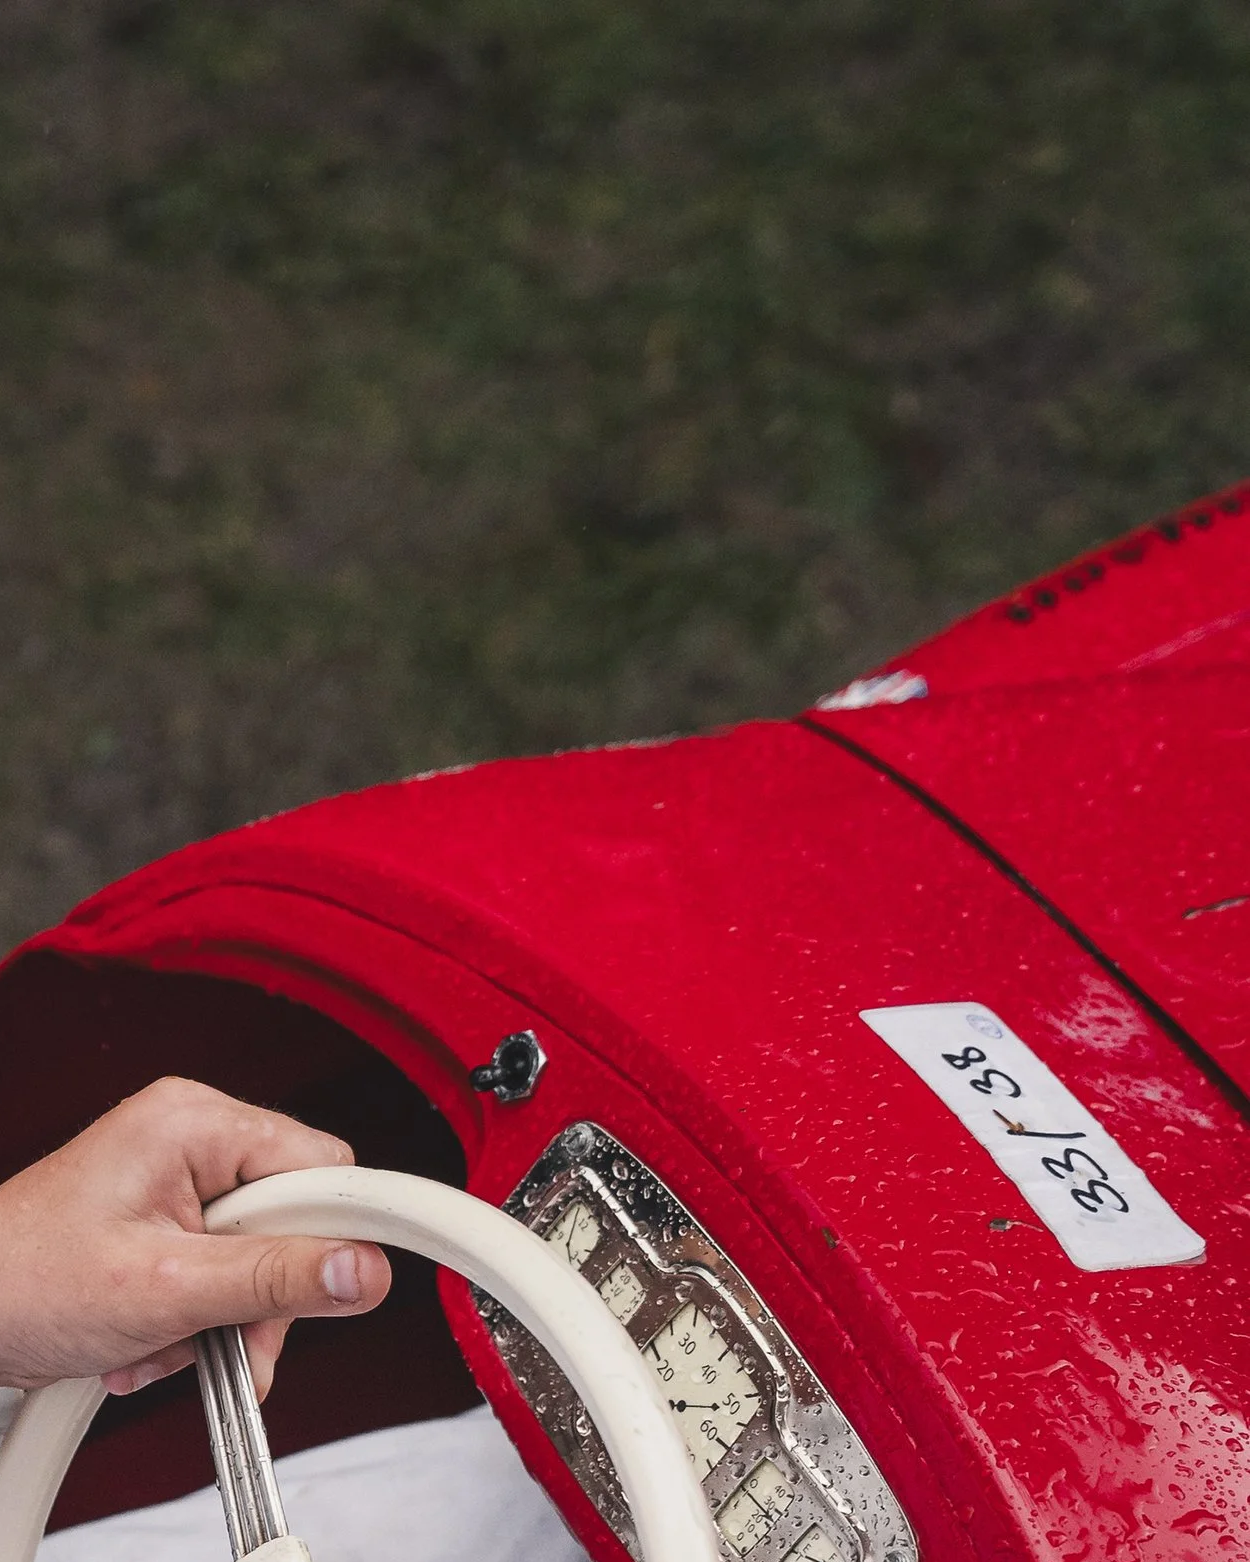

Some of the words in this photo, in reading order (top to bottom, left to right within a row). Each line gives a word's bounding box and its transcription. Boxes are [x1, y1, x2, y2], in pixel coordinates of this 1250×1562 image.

[577, 1219, 589, 1232] 12
[619, 1271, 631, 1285] 20
[677, 1332, 697, 1356] 30
[656, 1359, 675, 1382] 20
[701, 1364, 718, 1385] 40
[722, 1392, 741, 1416] 50
[700, 1419, 718, 1441] 60
[774, 1485, 786, 1499] 40
[764, 1497, 775, 1511] 30
[751, 1509, 763, 1523] 20
[744, 1519, 756, 1533] 10
[736, 1532, 745, 1542] 0
[828, 1552, 837, 1561] F
